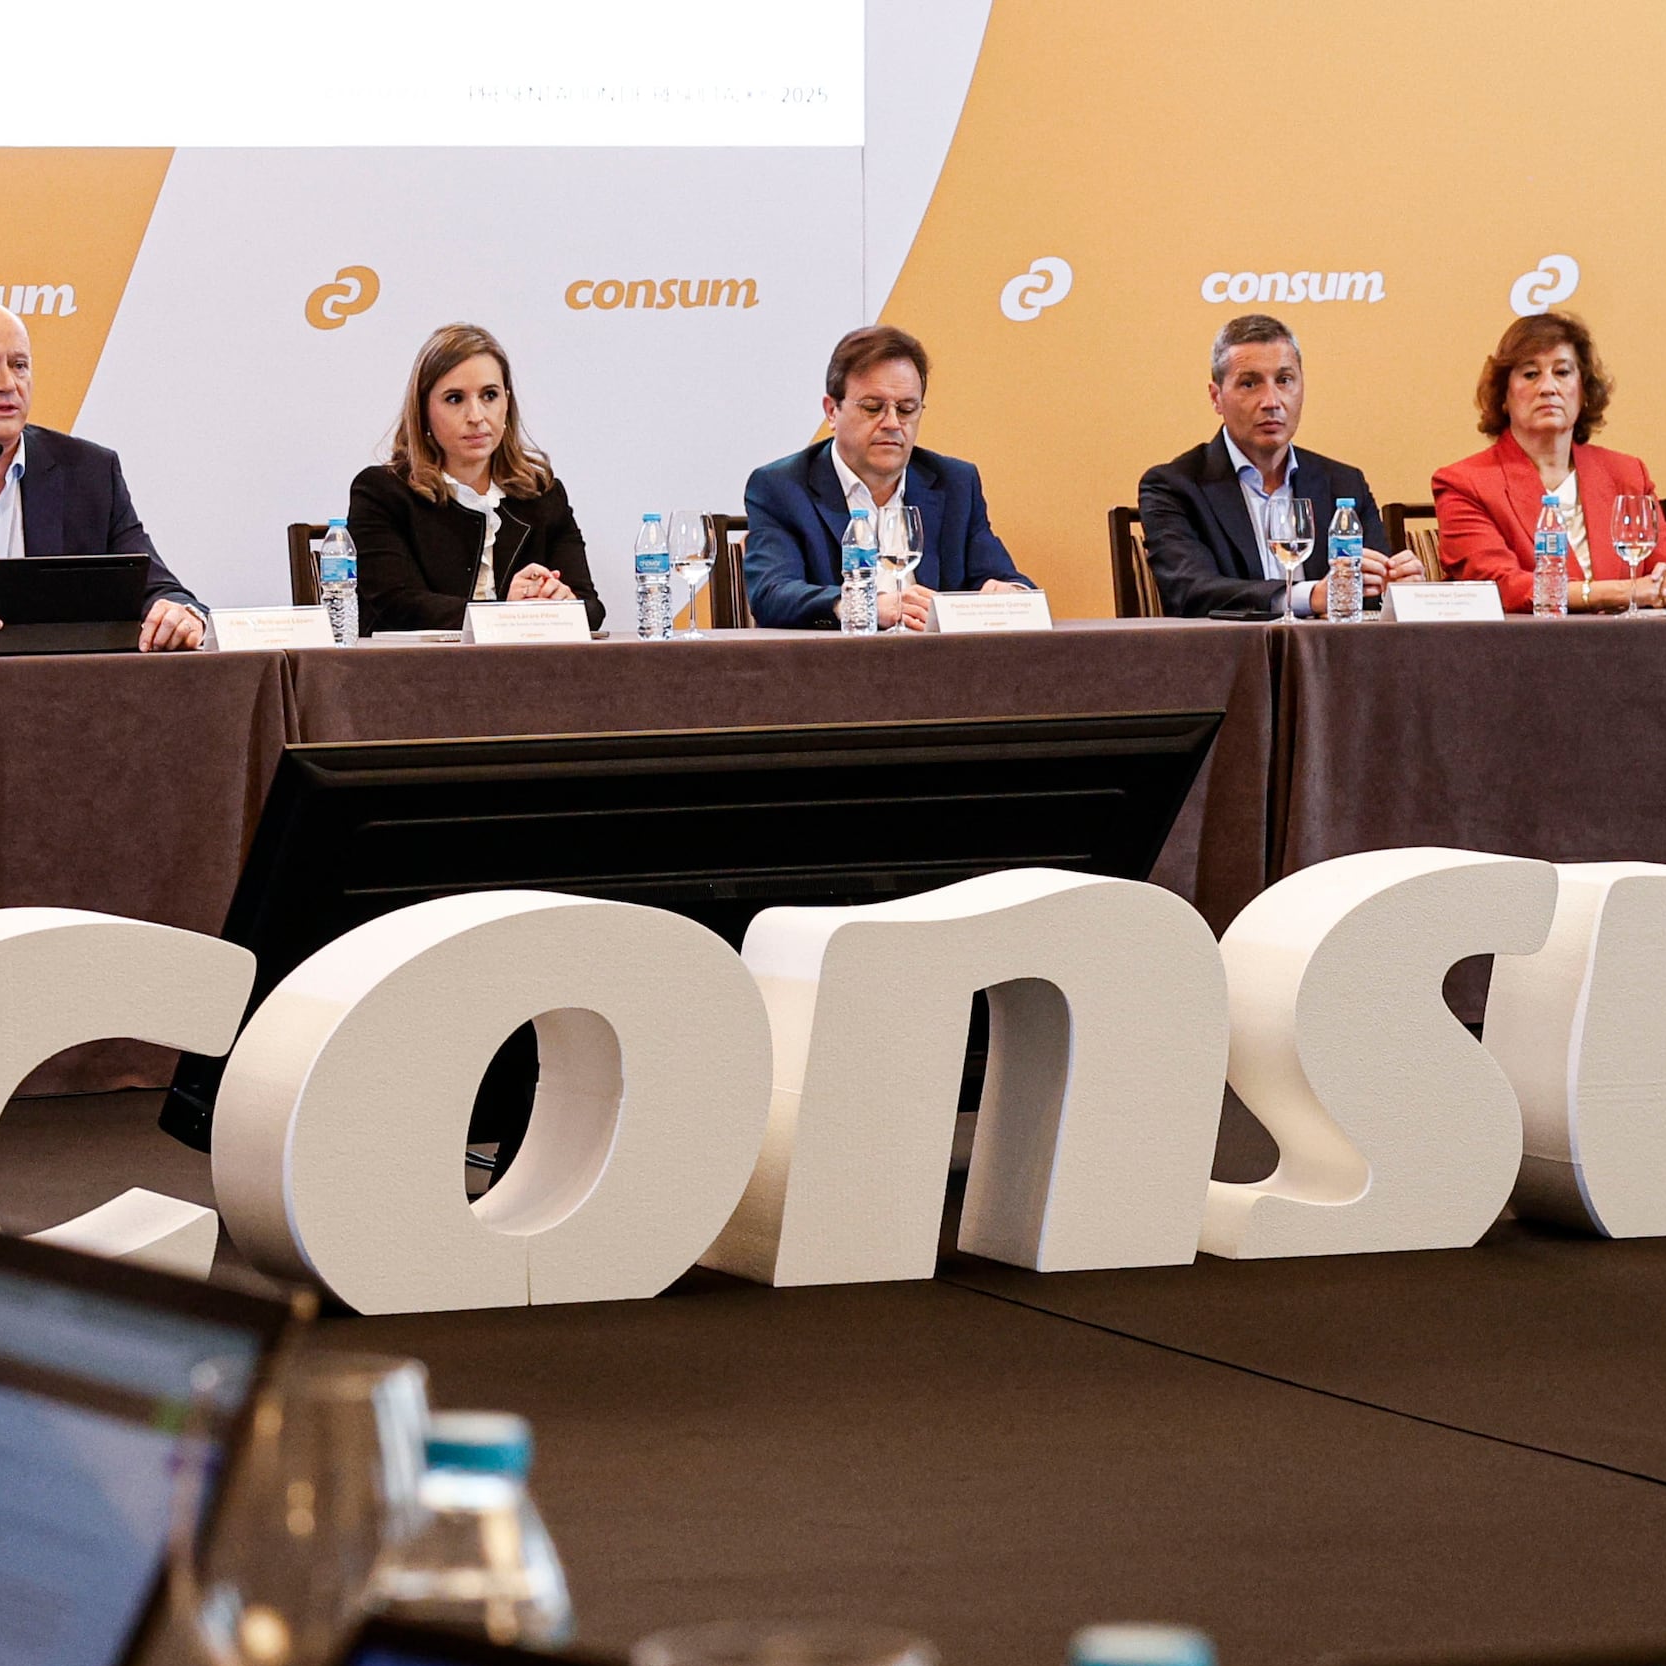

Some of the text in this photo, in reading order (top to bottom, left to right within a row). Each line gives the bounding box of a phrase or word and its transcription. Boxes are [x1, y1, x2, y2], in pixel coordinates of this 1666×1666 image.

[779, 85, 829, 104] 2025
[564, 278, 759, 310] consum
[1200, 270, 1386, 304] consum
